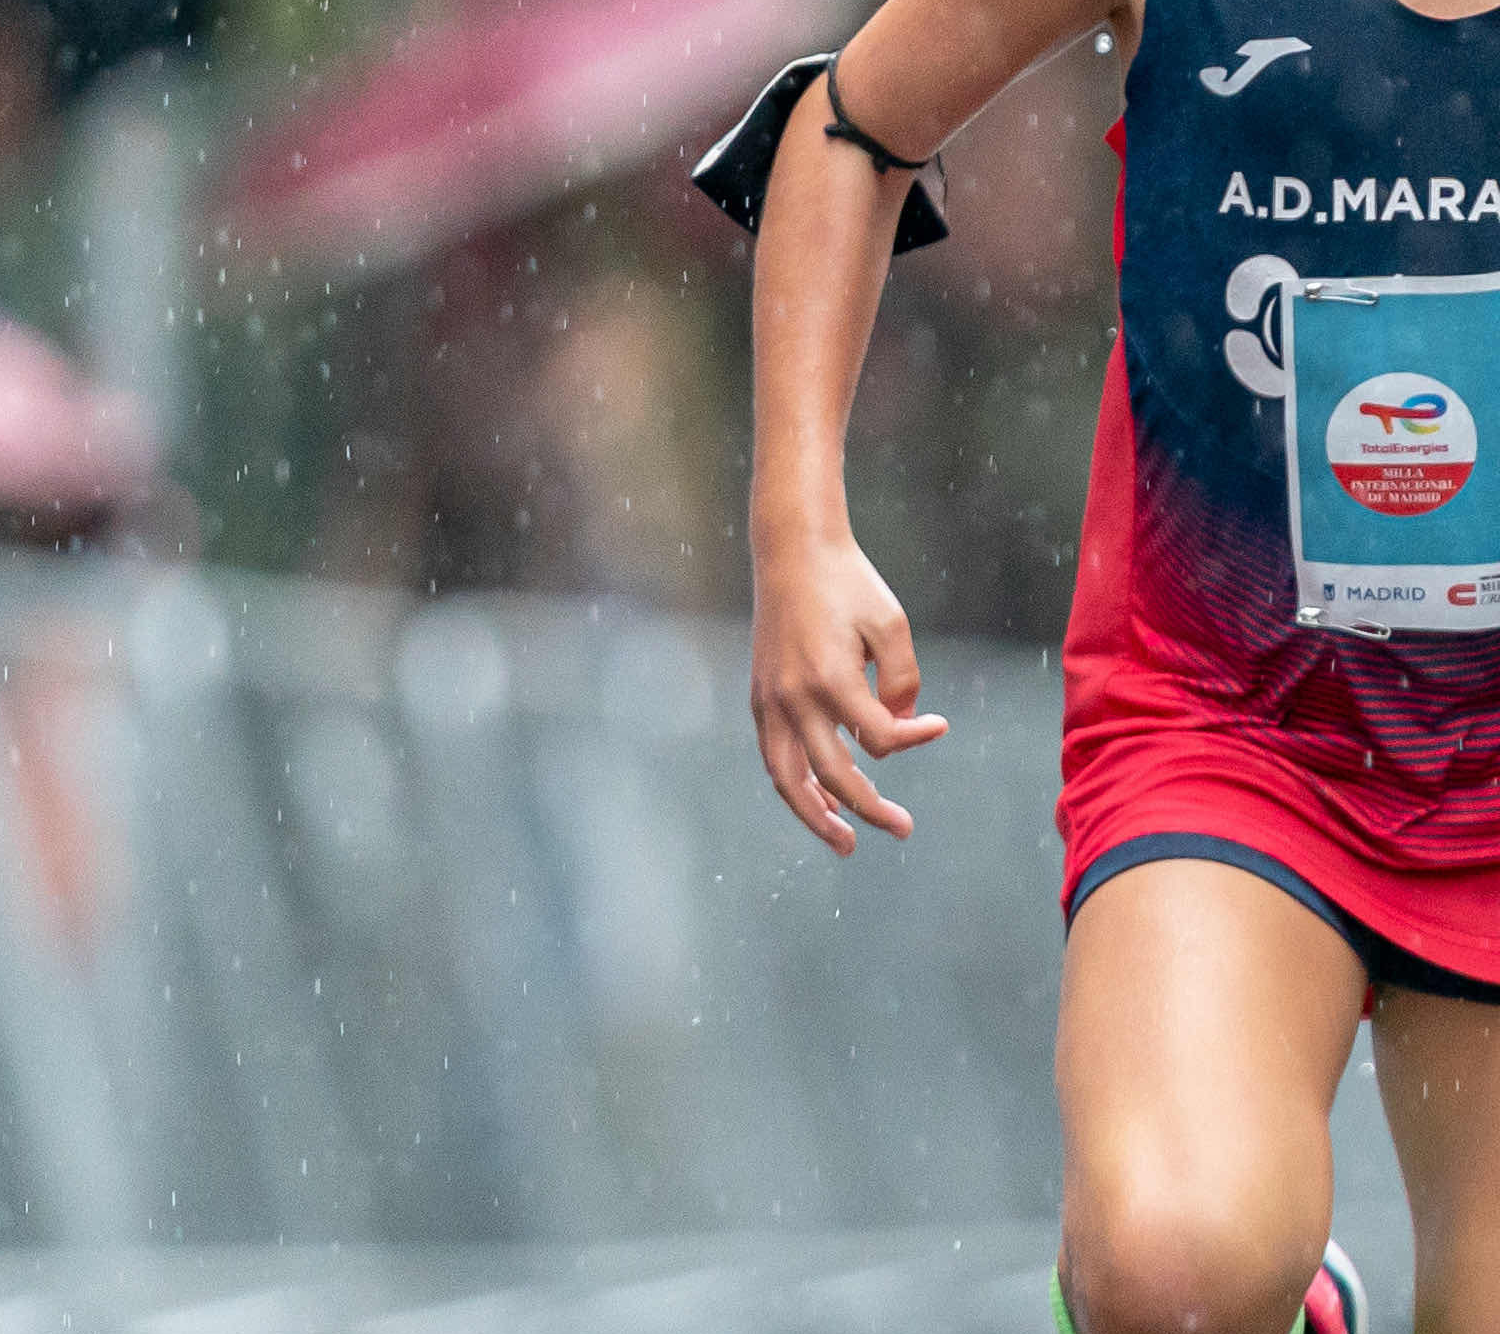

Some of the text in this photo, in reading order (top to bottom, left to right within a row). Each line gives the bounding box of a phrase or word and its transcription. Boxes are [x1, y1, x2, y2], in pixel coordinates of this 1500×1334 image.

[1360, 442, 1449, 455] TotalEnergies
[1382, 467, 1425, 479] MILLA
[1367, 491, 1442, 503] DE MADRID
[1346, 586, 1426, 601] MADRID
